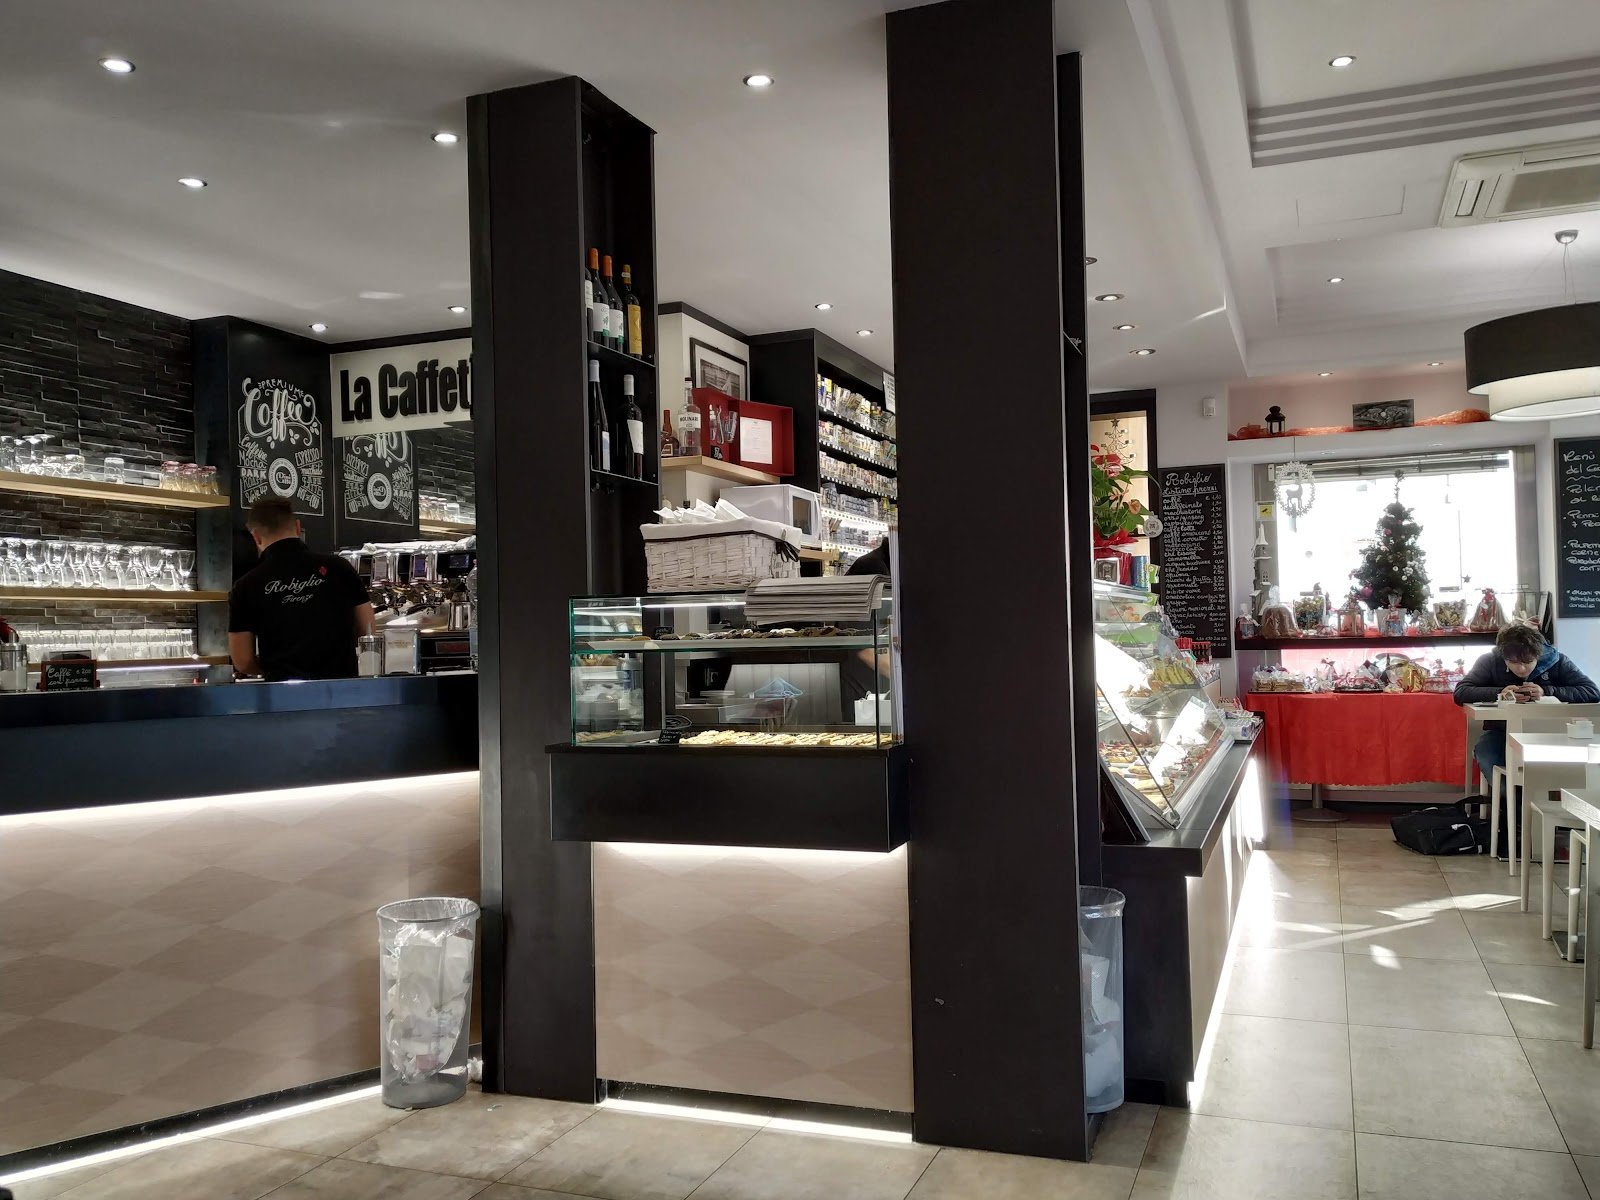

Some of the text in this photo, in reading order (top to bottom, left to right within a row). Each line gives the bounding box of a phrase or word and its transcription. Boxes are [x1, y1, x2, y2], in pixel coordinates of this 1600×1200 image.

[340, 353, 473, 421] La Caffet
[241, 377, 316, 442] Coffee
[241, 468, 267, 479] DARK
[1166, 472, 1212, 487] Robiglio
[264, 573, 325, 594] Robiglio
